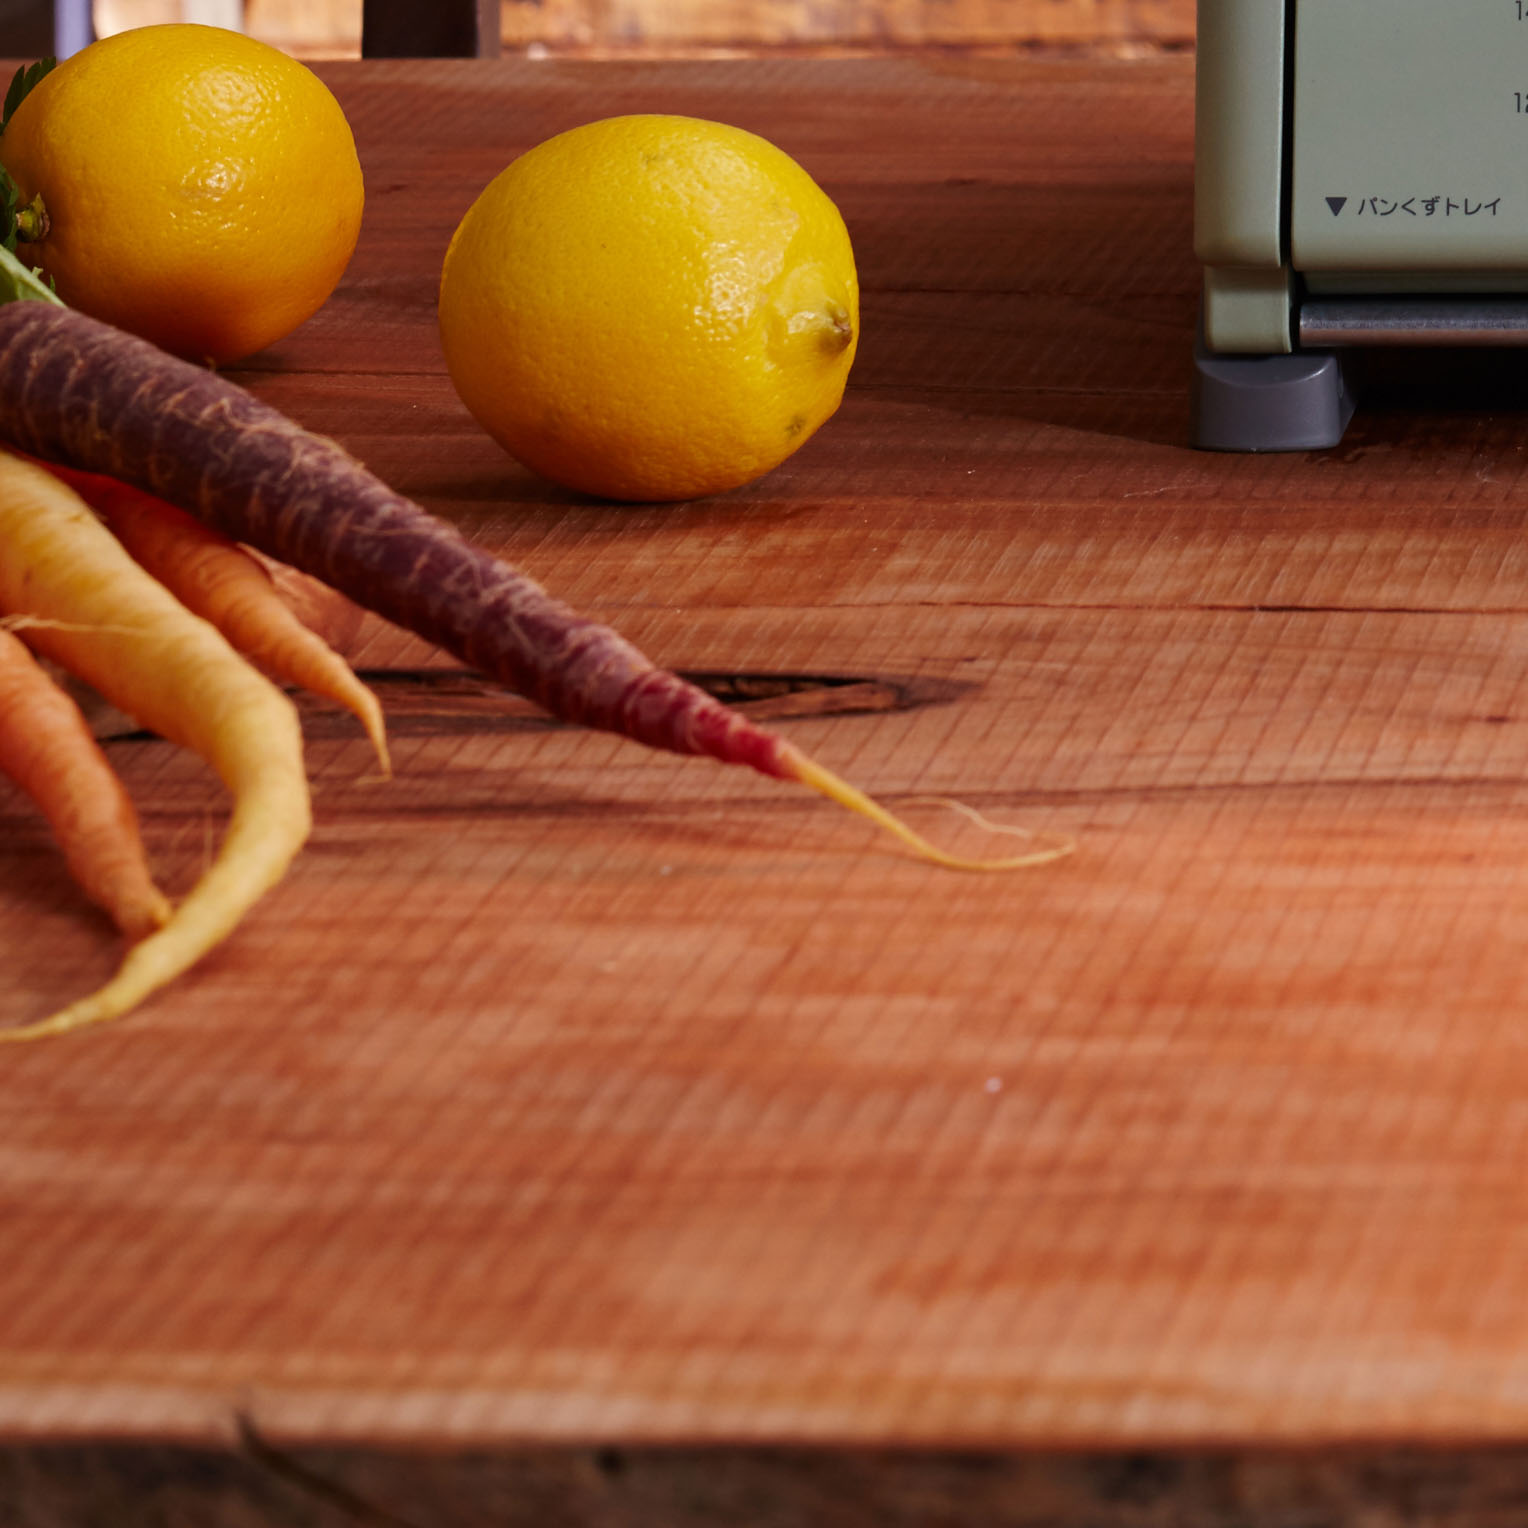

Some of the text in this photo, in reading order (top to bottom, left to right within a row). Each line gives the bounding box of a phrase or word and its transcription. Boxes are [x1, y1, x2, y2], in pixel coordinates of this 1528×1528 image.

[1357, 195, 1501, 217] パンくずトレイ
